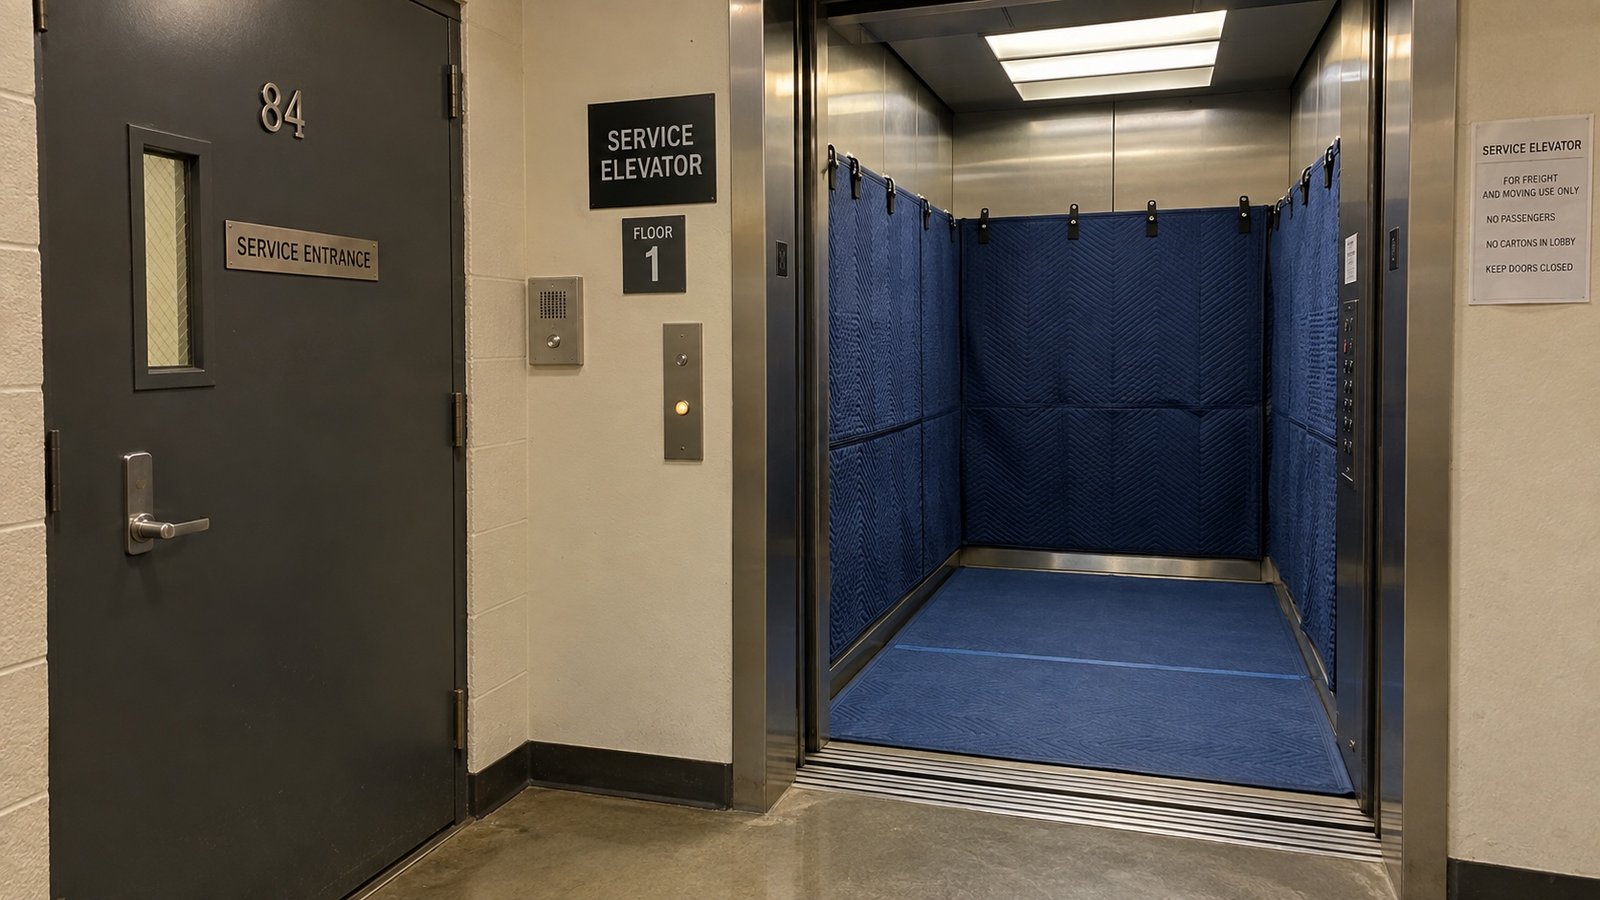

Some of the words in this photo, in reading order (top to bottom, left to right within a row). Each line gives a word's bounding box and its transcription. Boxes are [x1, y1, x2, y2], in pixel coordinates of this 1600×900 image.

[261, 82, 305, 138] 84
[607, 124, 694, 151] SERVICE
[1482, 143, 1526, 155] SERVICE
[1529, 139, 1582, 153] ELEVATOR
[601, 154, 702, 181] ELEVATOR
[1503, 176, 1520, 185] FOR
[1523, 174, 1558, 184] FREIGHT
[1482, 190, 1500, 199] AND
[1502, 188, 1536, 198] MOVING
[1539, 187, 1555, 197] USE
[1557, 186, 1580, 196] ONLY
[1486, 215, 1499, 224] NO
[1501, 213, 1556, 223] PASSENGERS
[633, 226, 673, 241] FLOOR
[1486, 240, 1498, 249] NO
[1500, 238, 1538, 248] CARTONS
[1539, 238, 1548, 247] IN
[1549, 237, 1576, 247] LOBBY
[237, 236, 299, 262] SERVICE
[304, 244, 371, 269] ENTRANCE
[645, 245, 659, 282] 1
[1485, 264, 1507, 274] KEEP
[1509, 264, 1538, 273] DOORS
[1540, 262, 1574, 272] CLOSED
